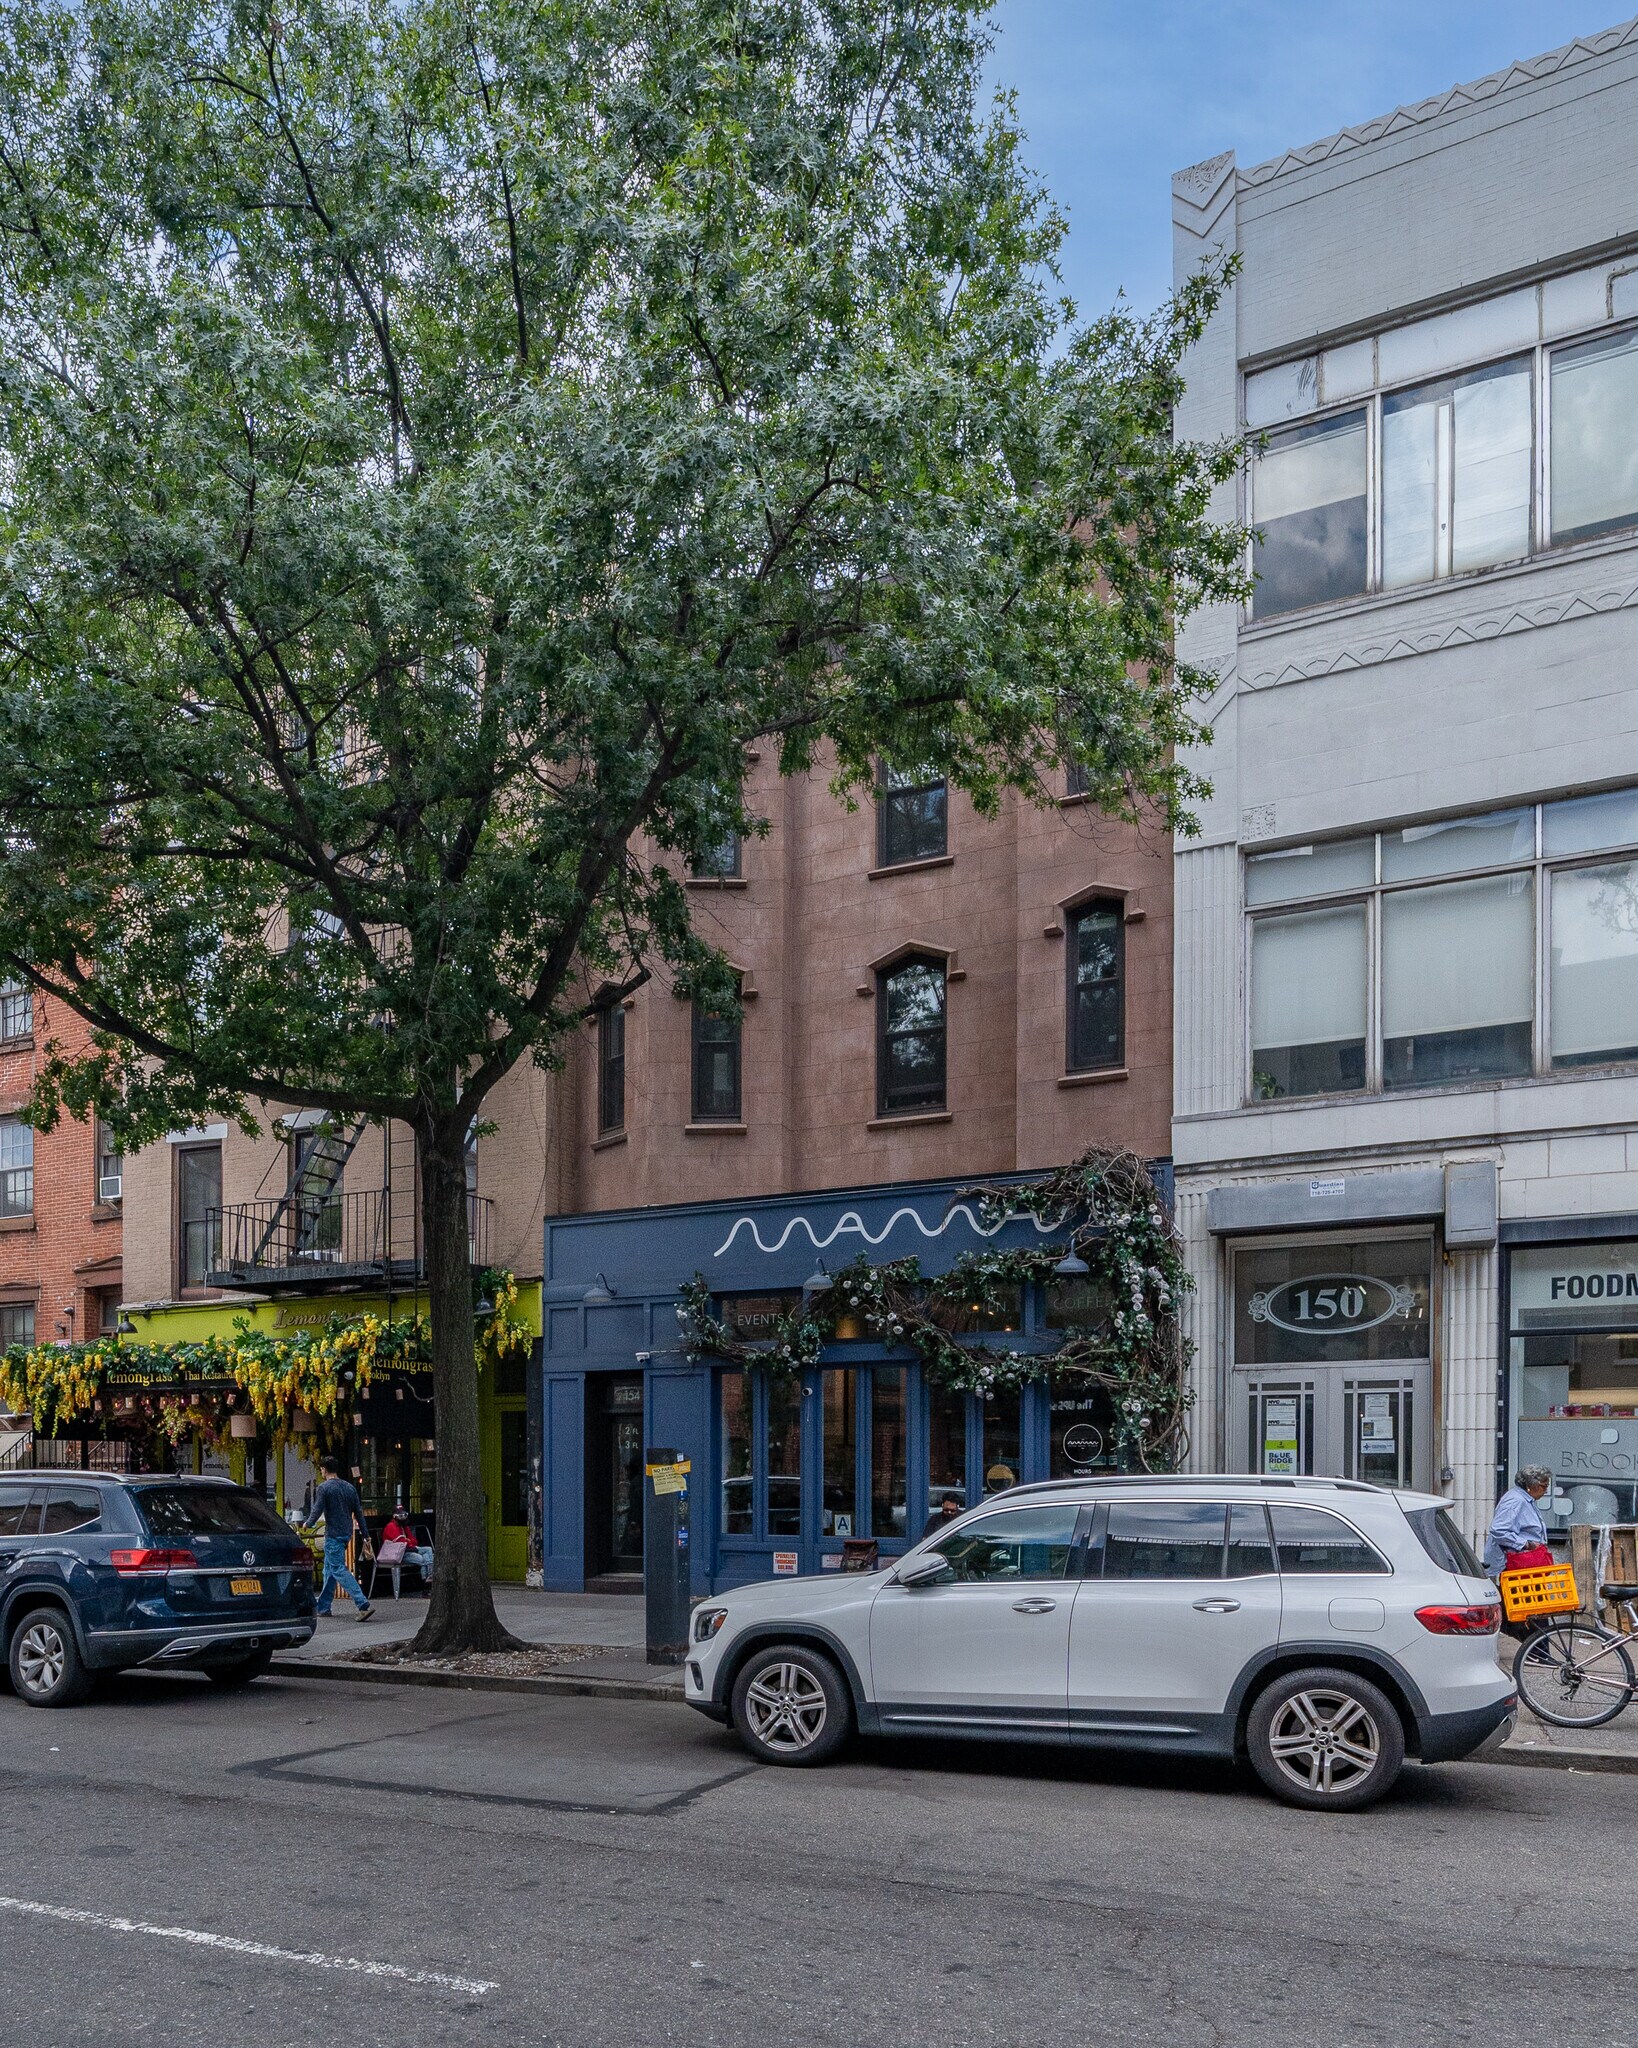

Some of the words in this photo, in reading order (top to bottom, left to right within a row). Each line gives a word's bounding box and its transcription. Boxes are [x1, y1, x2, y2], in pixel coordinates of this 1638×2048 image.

[1294, 1287, 1364, 1321] 150
[372, 1356, 434, 1375] lemongras
[371, 1369, 391, 1383] oklyn
[625, 1426, 631, 1435] 2
[625, 1440, 631, 1449] 3
[837, 1516, 849, 1530] A
